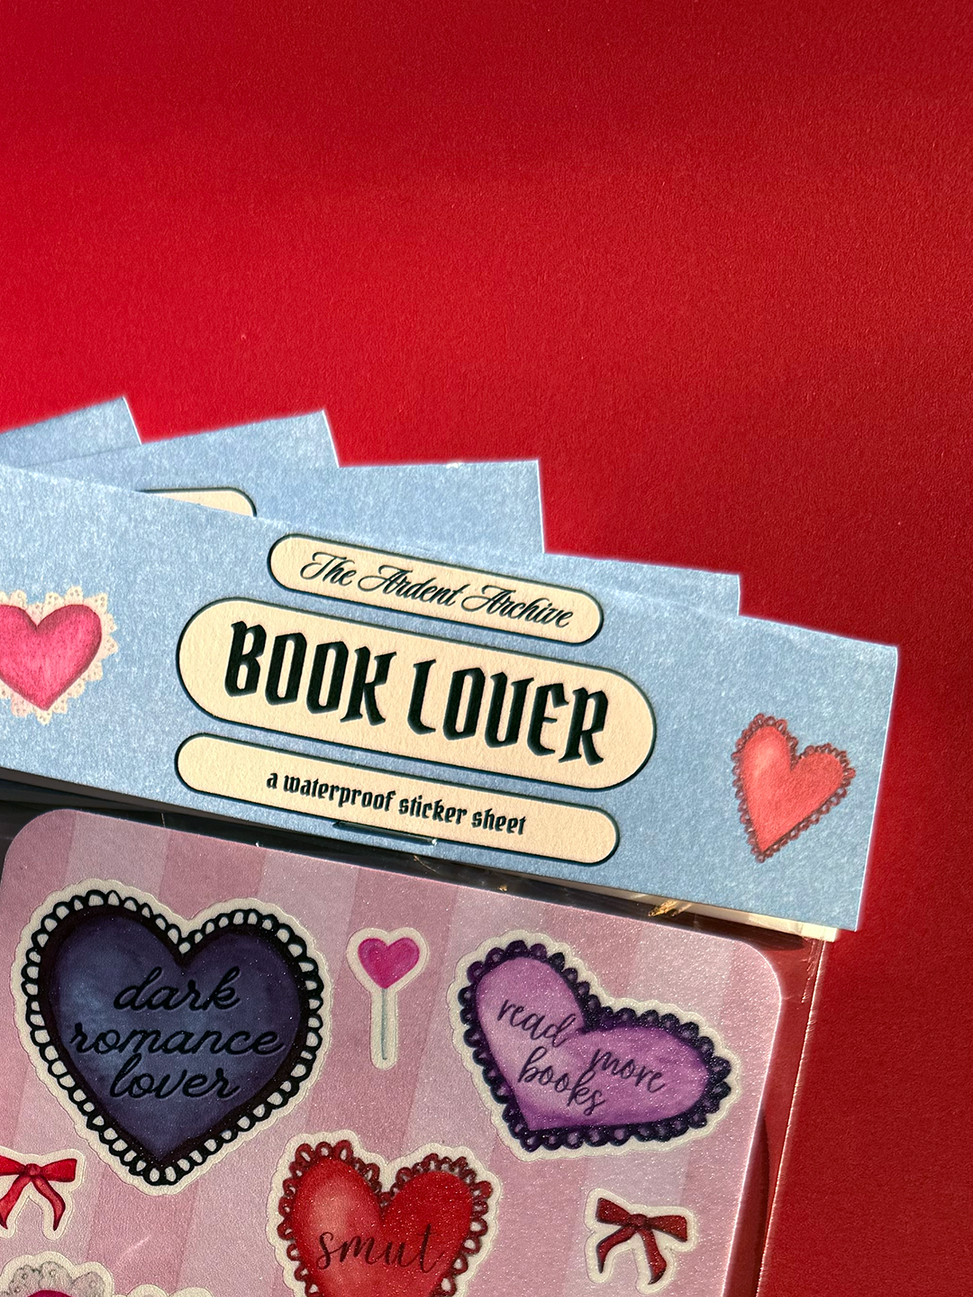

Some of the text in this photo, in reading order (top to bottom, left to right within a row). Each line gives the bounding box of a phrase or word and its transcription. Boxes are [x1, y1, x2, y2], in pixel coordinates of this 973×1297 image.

[299, 551, 574, 628] The Ardent Archive
[225, 619, 397, 727] BOOK
[266, 772, 526, 836] a waterproof sticker sheet
[113, 965, 241, 1012] dark
[69, 1022, 285, 1055] romance
[497, 999, 666, 1093] read more
[109, 1053, 241, 1099] lover
[517, 1045, 606, 1116] books
[316, 1223, 445, 1274] smut
